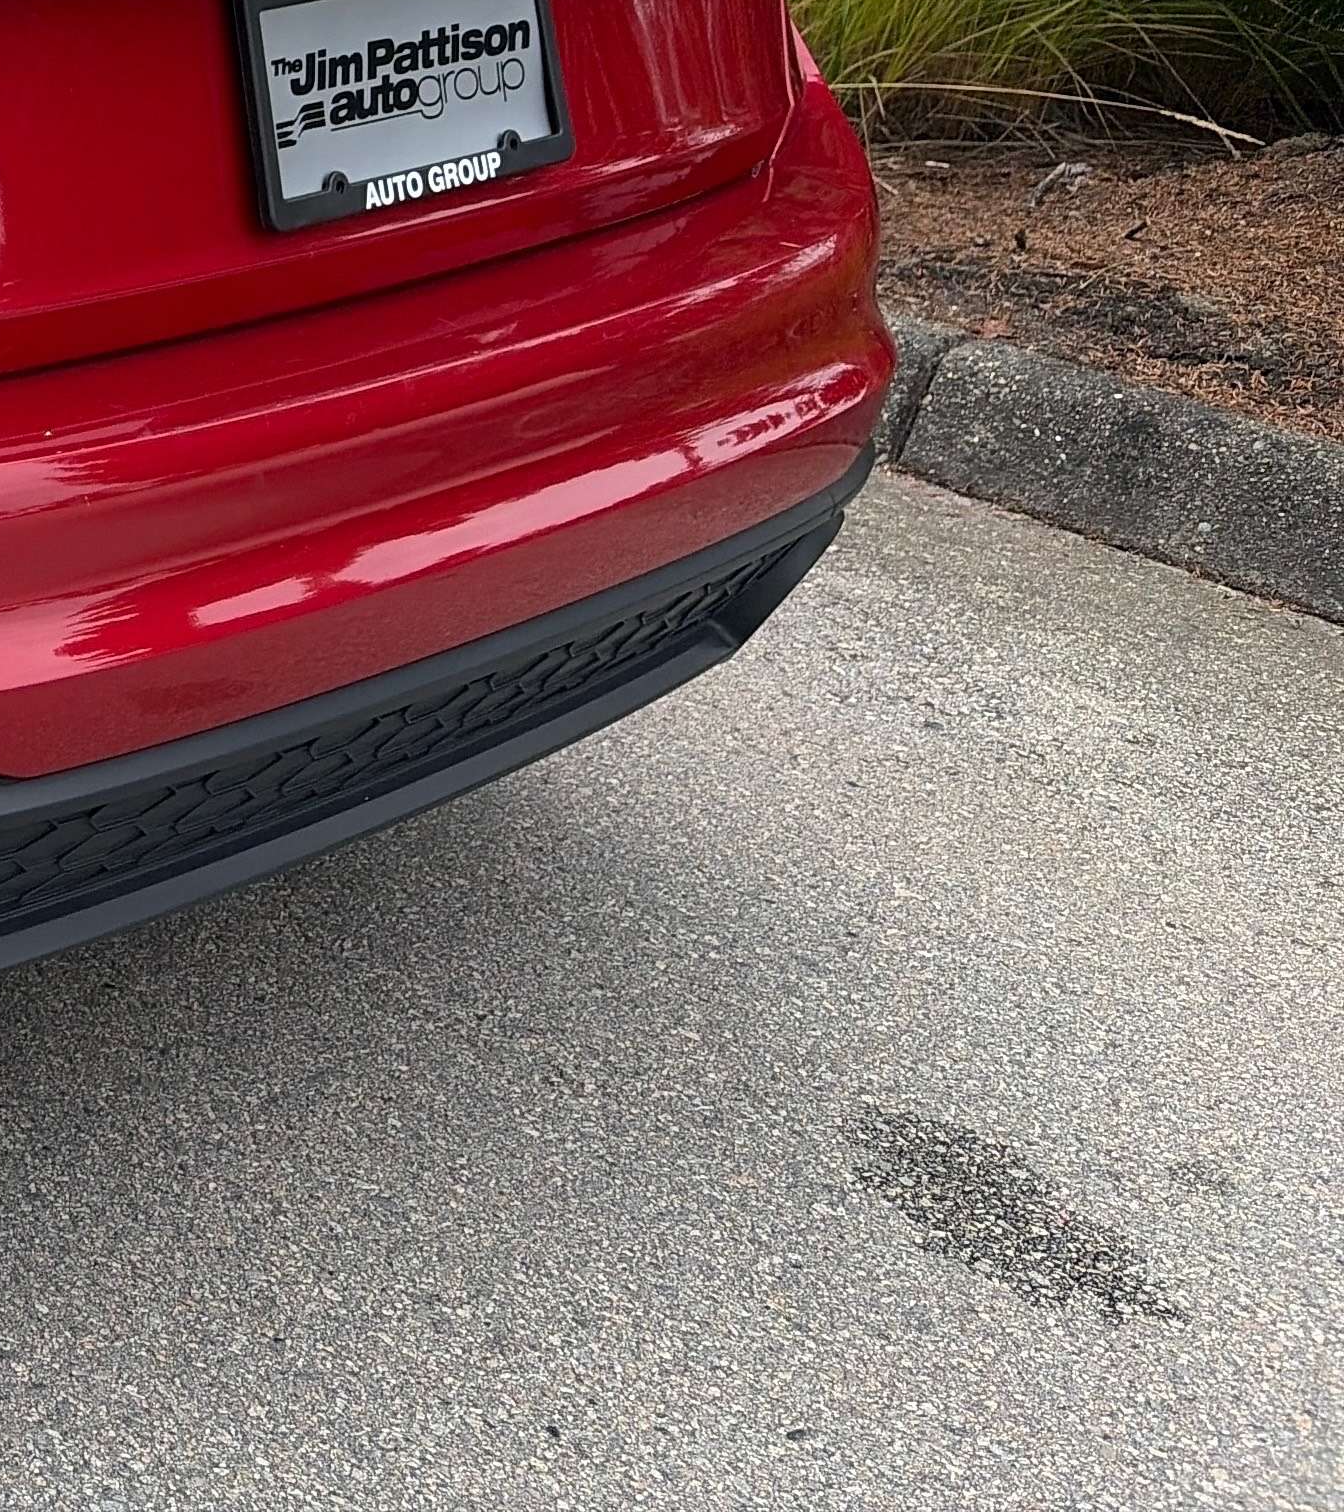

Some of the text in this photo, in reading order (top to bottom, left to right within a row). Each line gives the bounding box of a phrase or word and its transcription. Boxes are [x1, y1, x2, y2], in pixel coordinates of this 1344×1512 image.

[271, 58, 303, 77] The
[365, 151, 502, 210] AUTO GROUP
